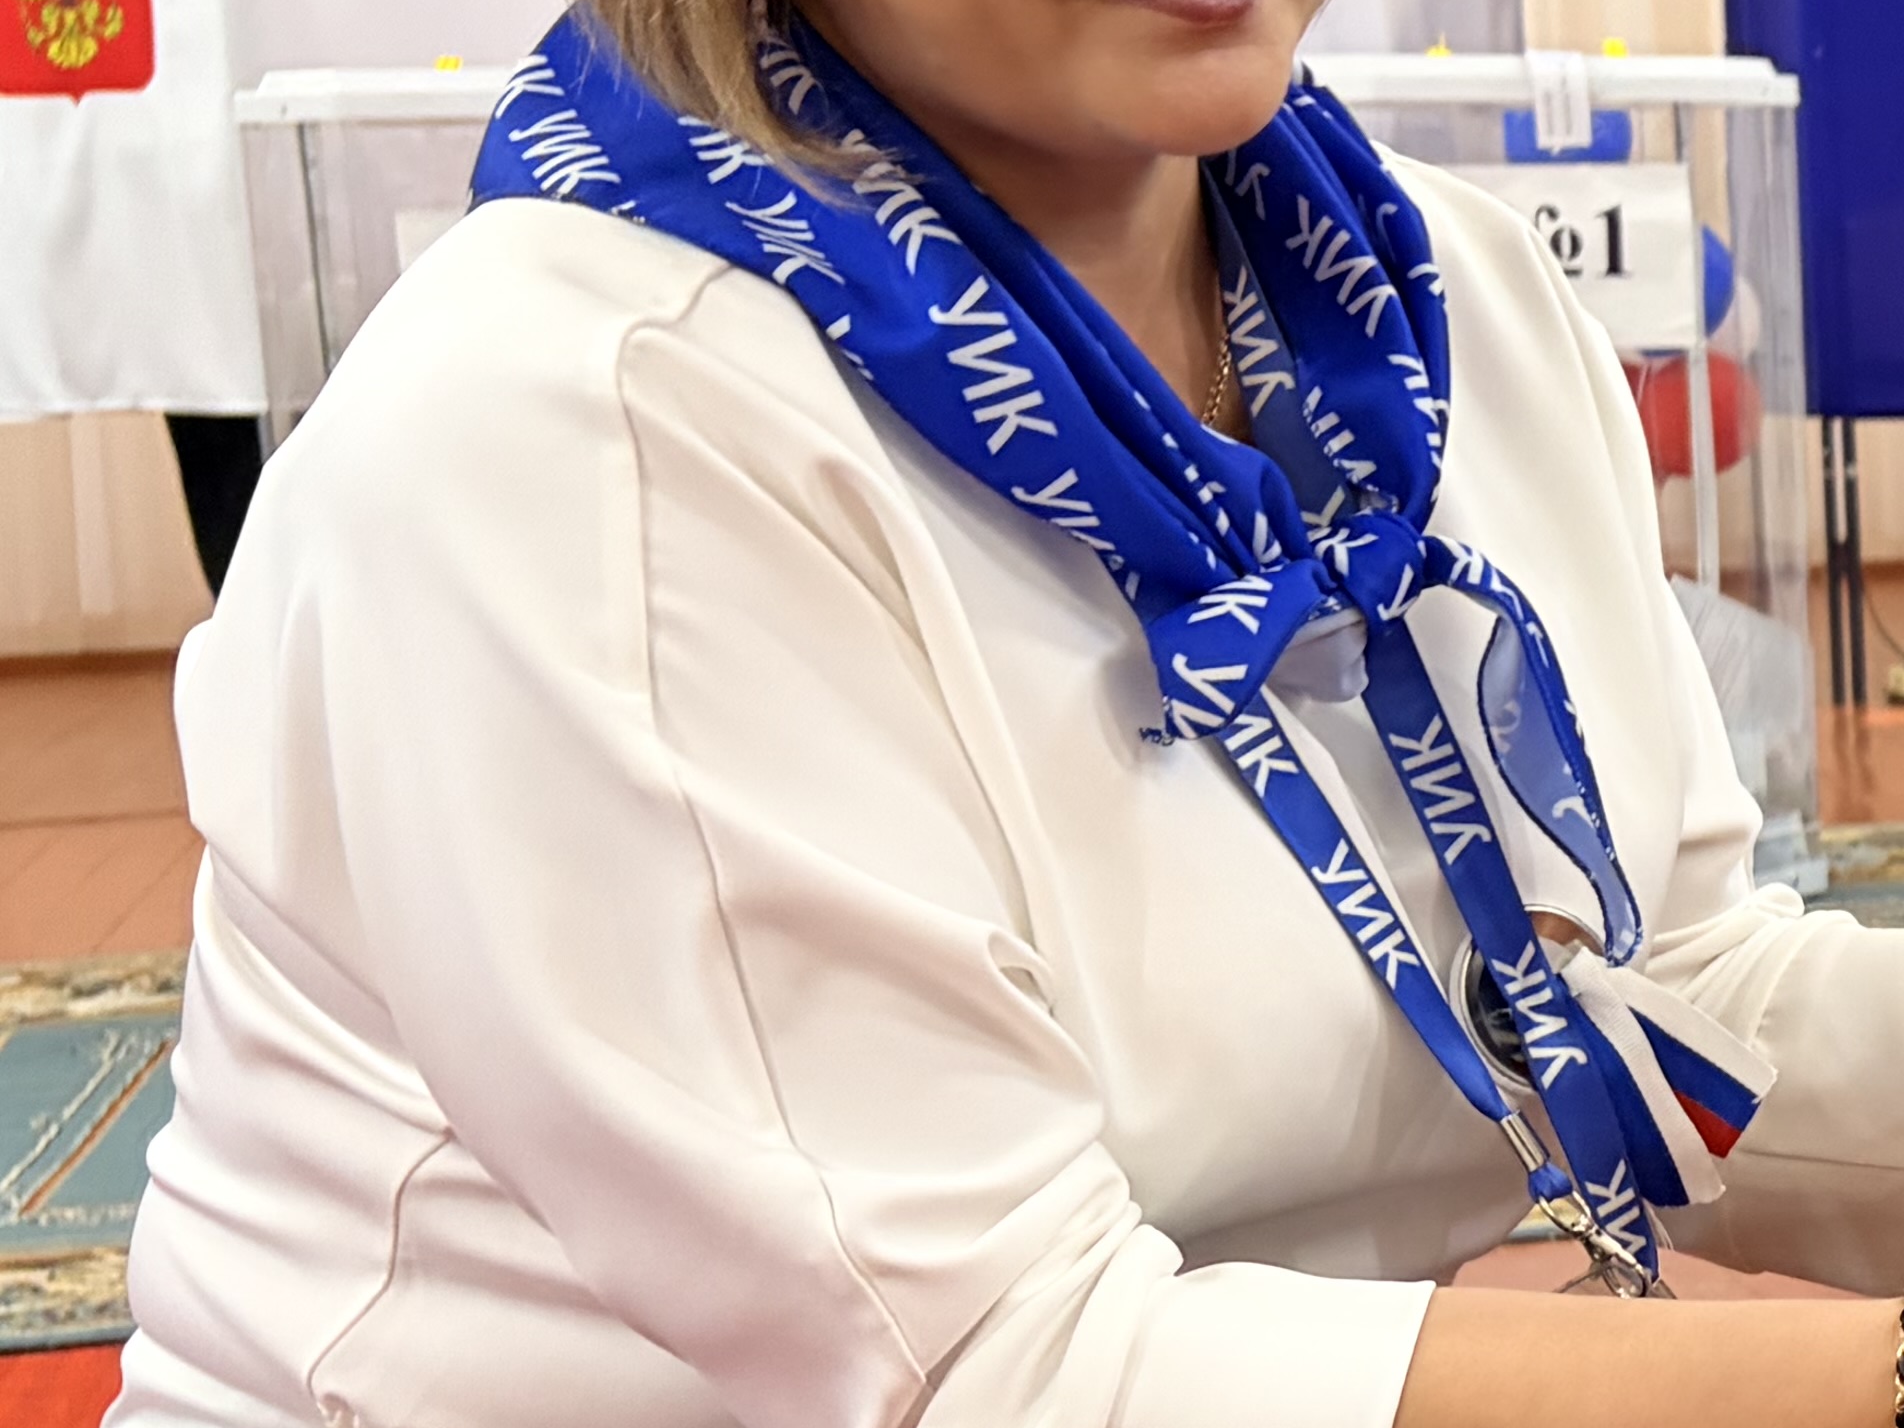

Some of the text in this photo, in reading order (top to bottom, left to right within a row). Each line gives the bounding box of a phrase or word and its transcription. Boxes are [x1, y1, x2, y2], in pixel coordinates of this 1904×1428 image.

[509, 109, 622, 196] УИК
[726, 192, 845, 286] УИК
[1286, 194, 1397, 338] УИК
[928, 276, 1058, 457] УИК
[1222, 265, 1296, 418] УИК
[1388, 714, 1491, 864] УИК
[1311, 838, 1420, 990] УИК
[1491, 939, 1588, 1089] УИК
